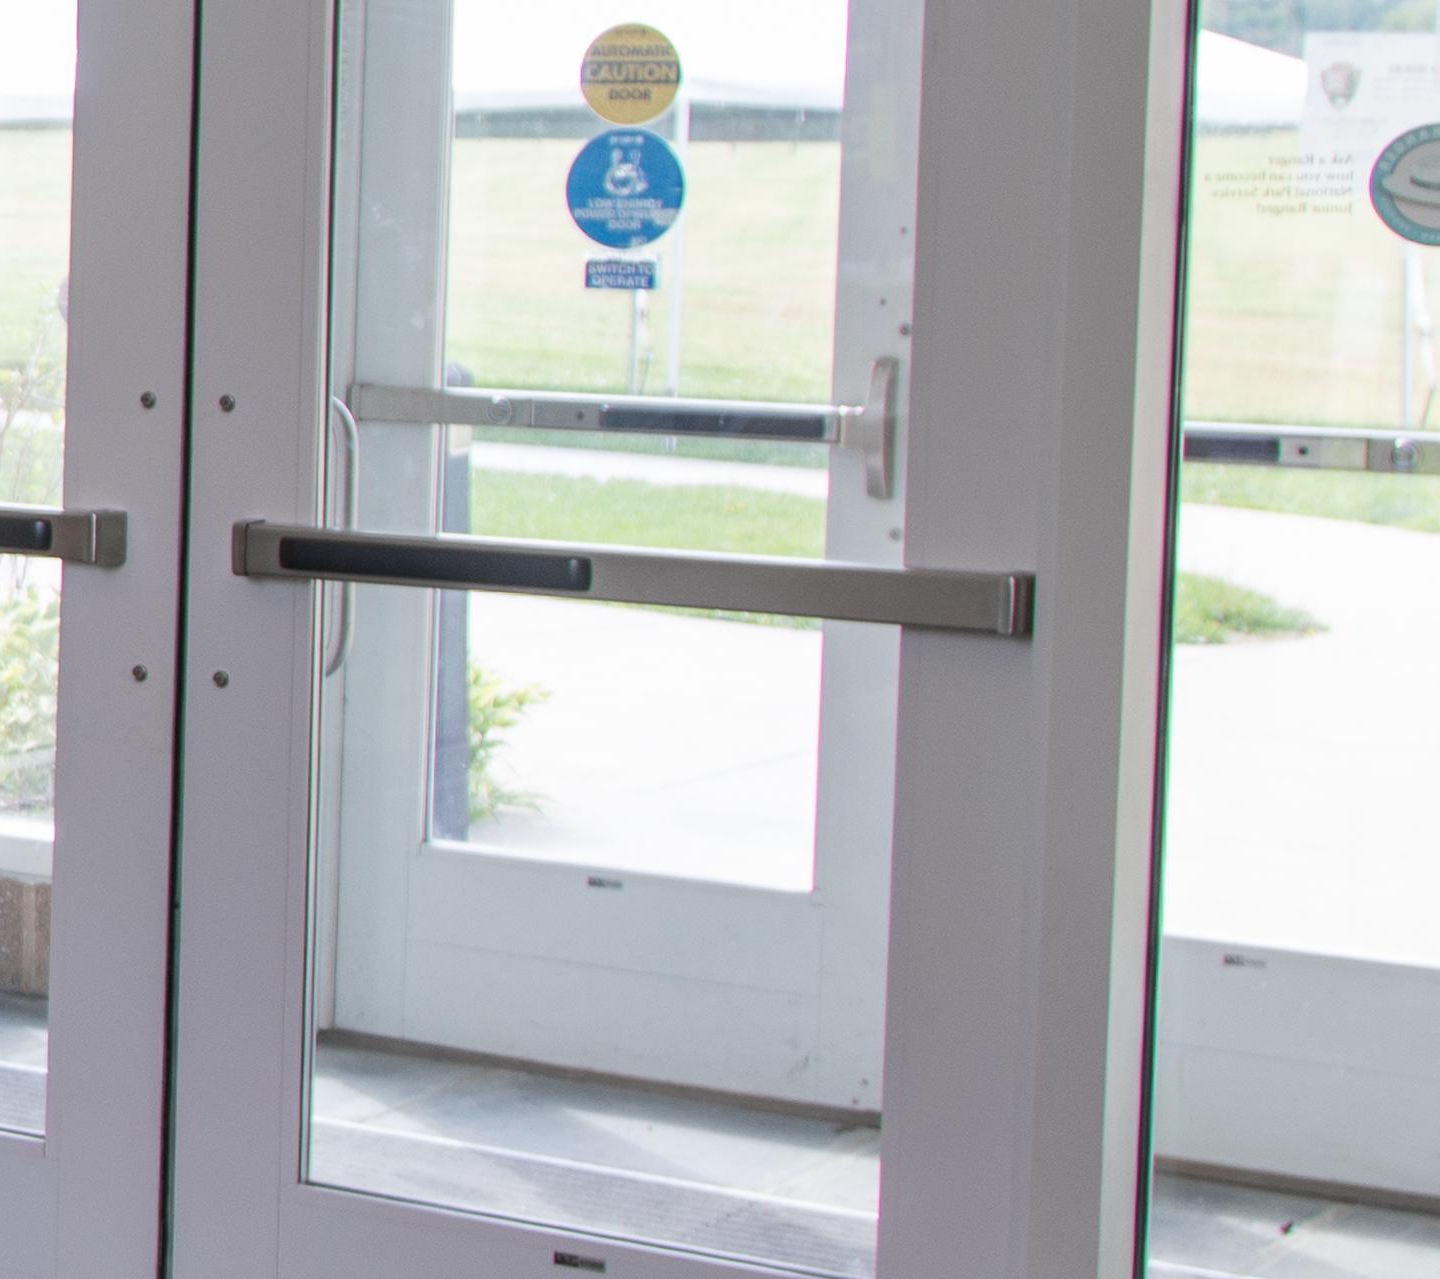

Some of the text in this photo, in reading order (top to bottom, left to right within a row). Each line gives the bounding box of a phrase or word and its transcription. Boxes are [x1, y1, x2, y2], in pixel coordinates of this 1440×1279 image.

[591, 44, 671, 57] AUTOMATIC
[587, 63, 676, 81] CAUTION
[609, 88, 652, 100] DOOR
[592, 275, 649, 287] OPERATE
